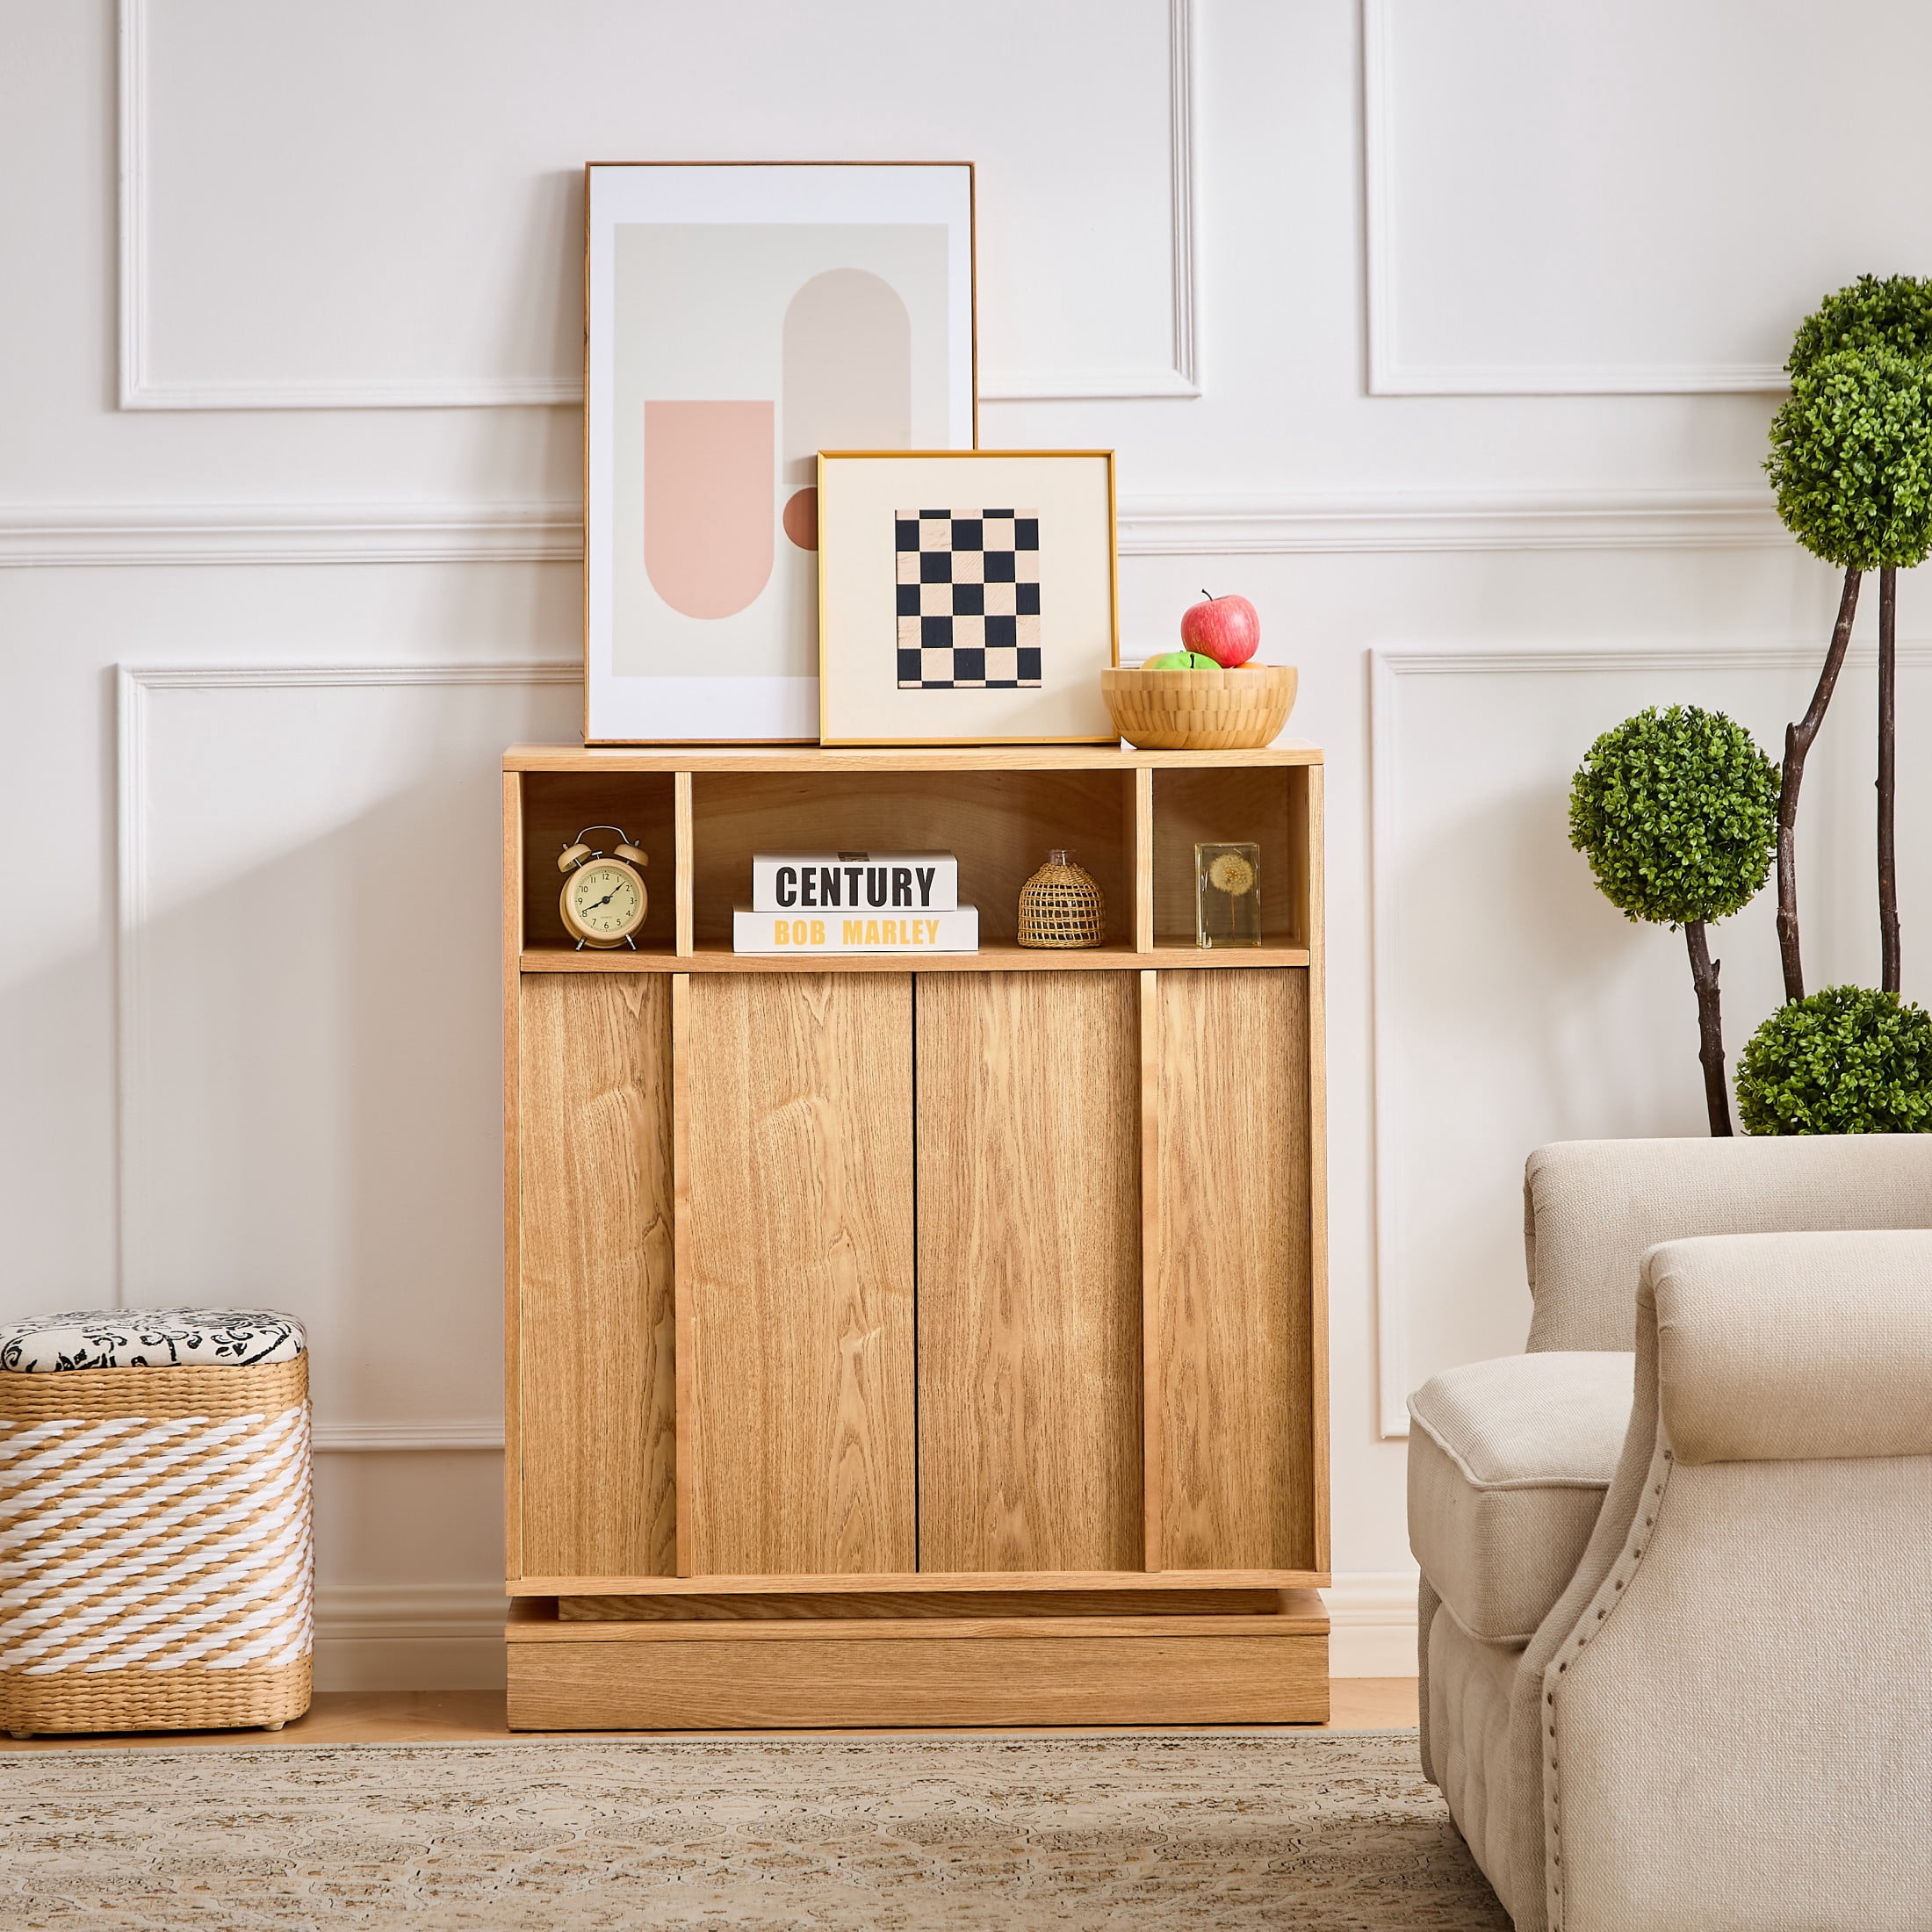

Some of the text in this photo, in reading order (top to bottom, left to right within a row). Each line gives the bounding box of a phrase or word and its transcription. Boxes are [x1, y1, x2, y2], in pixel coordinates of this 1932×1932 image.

[775, 866, 936, 907] CENTURY
[775, 919, 940, 945] BOB MARLEY
